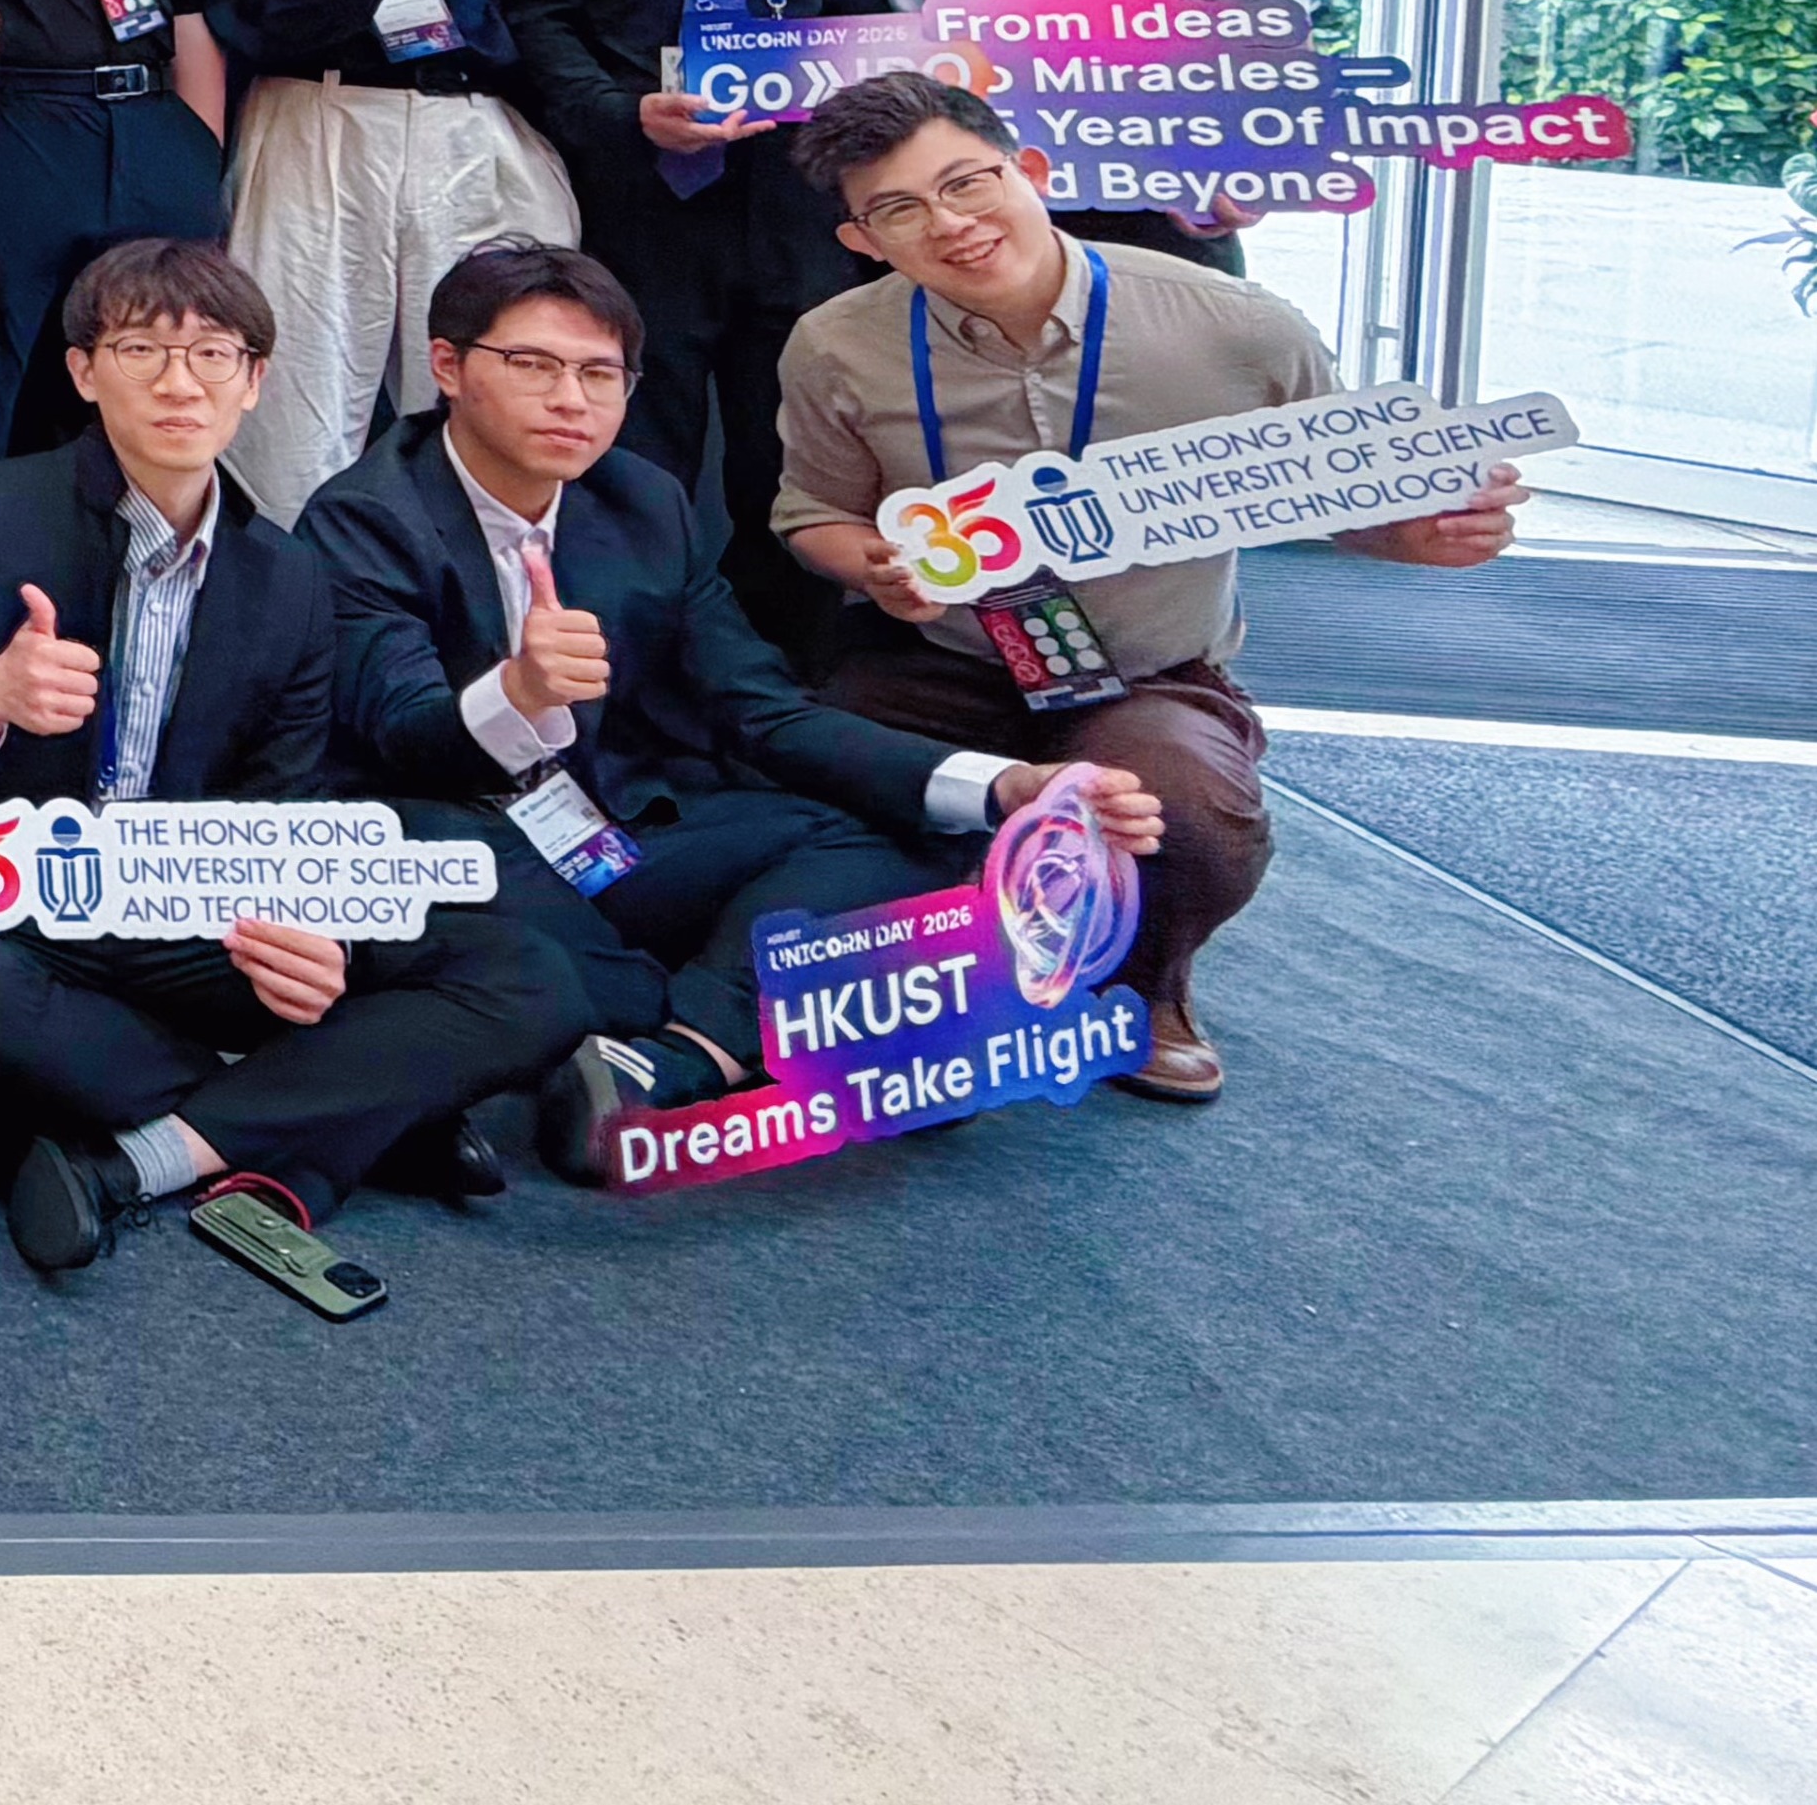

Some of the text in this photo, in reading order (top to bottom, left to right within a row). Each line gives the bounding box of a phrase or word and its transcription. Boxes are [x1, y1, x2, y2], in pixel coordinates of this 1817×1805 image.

[936, 1, 1294, 40] From Ideas
[700, 62, 794, 114] Go
[1035, 55, 1320, 93] Miracles
[1042, 104, 1611, 156] Years Of Impact
[1101, 163, 1358, 212] Beyone
[115, 818, 385, 847] THE HONG KONG
[118, 856, 479, 886] UNIVERSITY OF SCIENCE
[121, 896, 413, 925] AND TECHNOLOGY
[773, 953, 978, 1059] HKUST
[620, 1002, 1137, 1184] Dreams Take Flight
